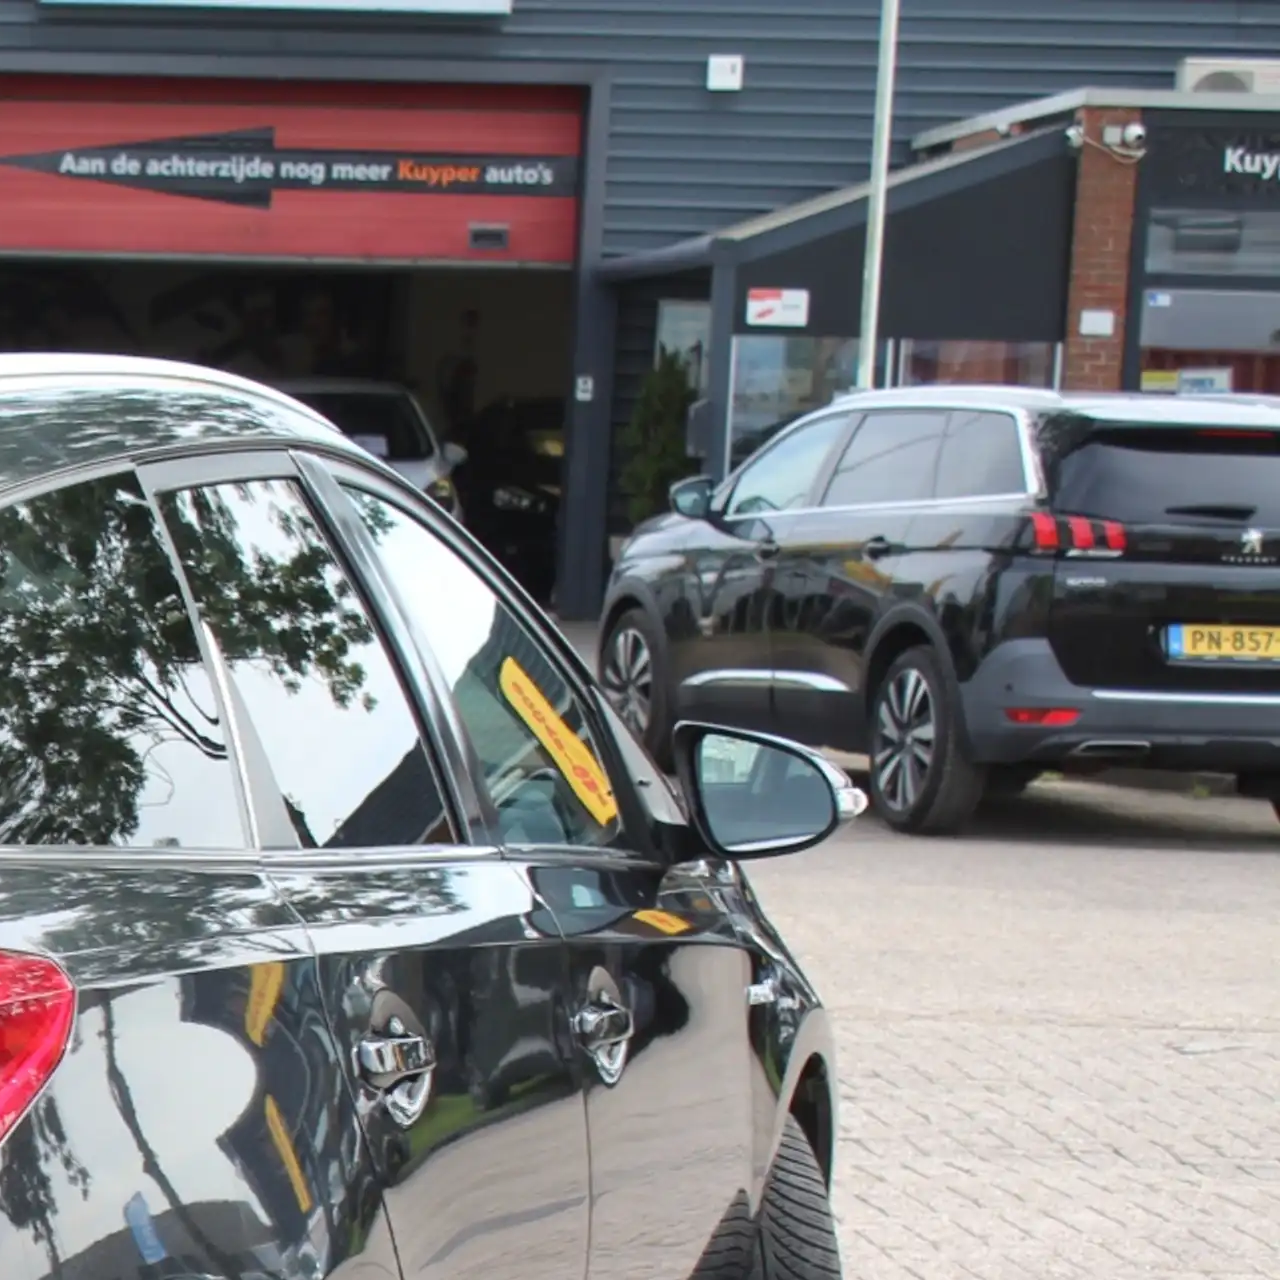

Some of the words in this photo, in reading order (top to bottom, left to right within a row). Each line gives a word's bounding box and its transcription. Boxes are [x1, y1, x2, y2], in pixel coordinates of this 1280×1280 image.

[58, 151, 106, 175] Aan
[110, 152, 141, 176] de
[145, 154, 275, 184] achterzijde
[279, 160, 327, 185] nog
[330, 161, 393, 182] meer
[397, 158, 481, 187] Kuyper
[484, 161, 554, 186] auto's
[1224, 147, 1280, 181] Kuy
